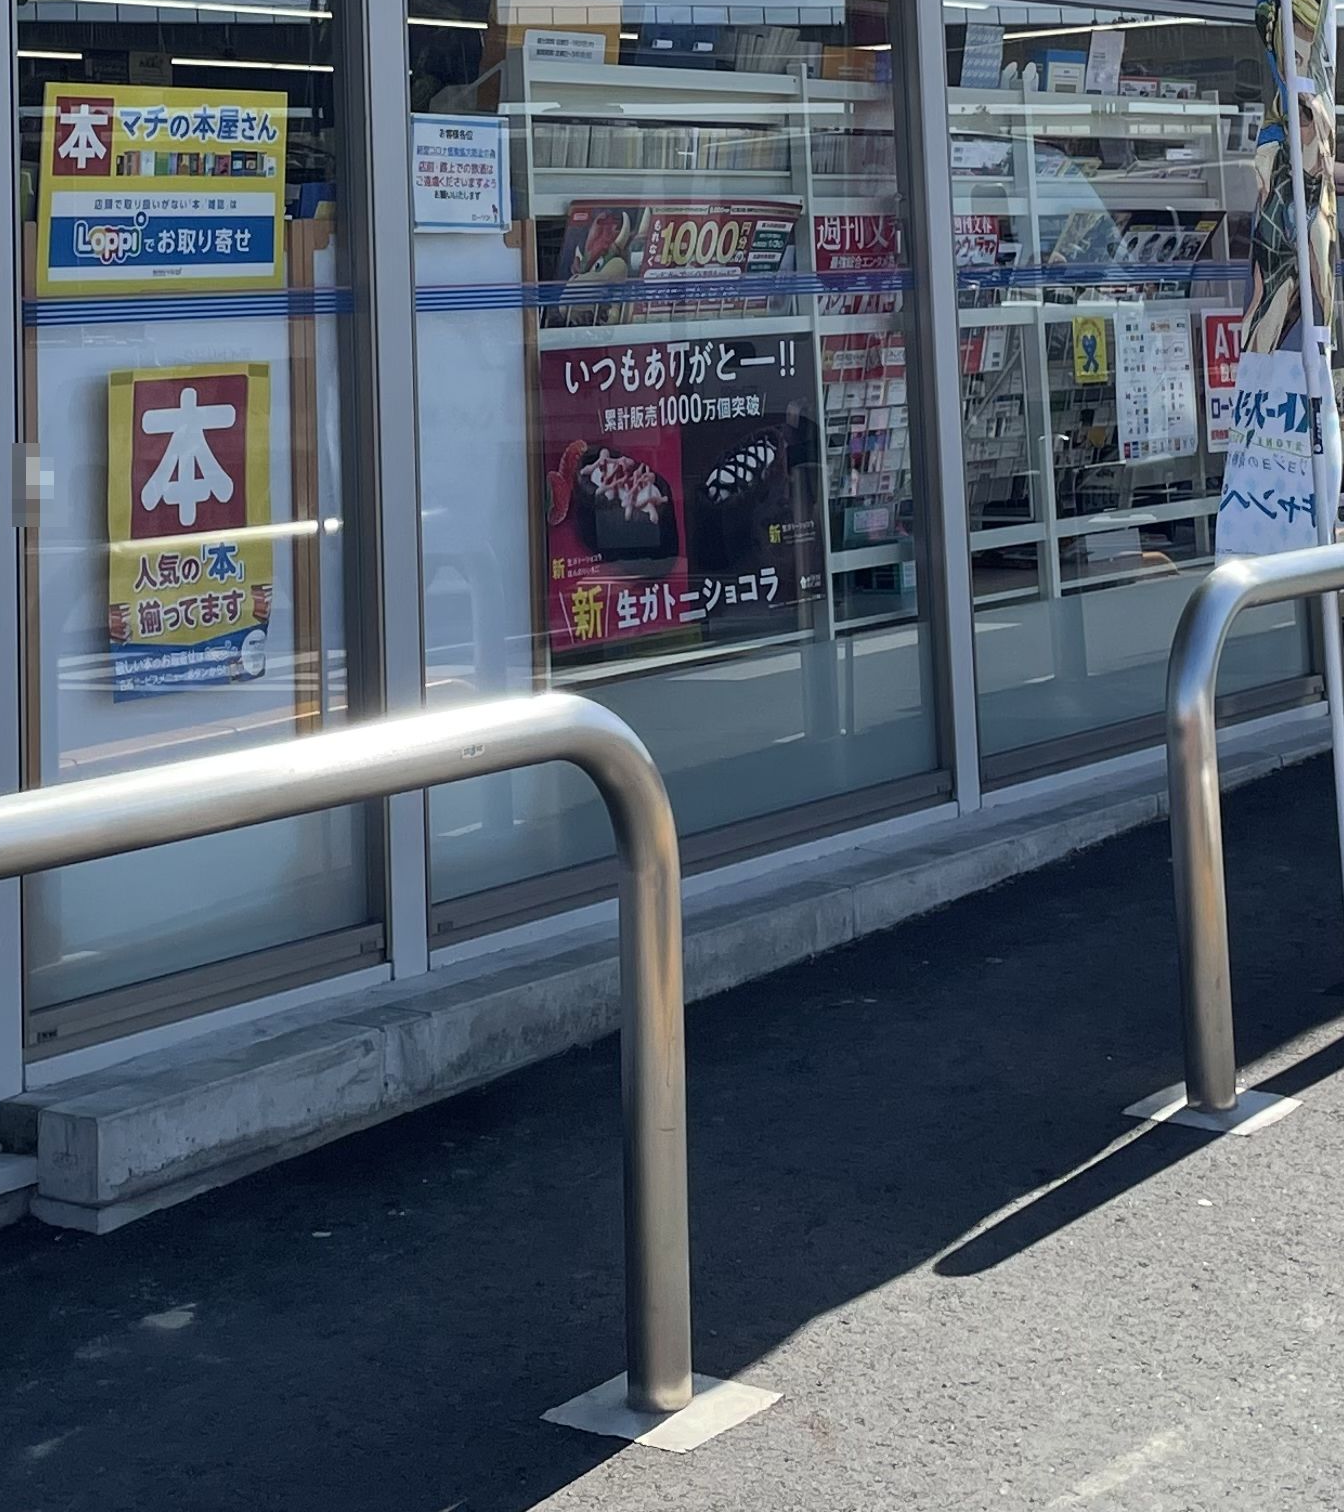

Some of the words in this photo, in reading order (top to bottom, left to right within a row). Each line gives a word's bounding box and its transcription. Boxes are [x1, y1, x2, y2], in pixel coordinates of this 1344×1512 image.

[58, 104, 109, 169] 本
[119, 106, 279, 143] マチの本屋さん
[141, 388, 236, 526] 本
[134, 542, 244, 590] 人気の「本」
[138, 590, 244, 635] 揃ってます
[571, 585, 604, 641] 新
[617, 567, 779, 629] 生ガトーショコラ
